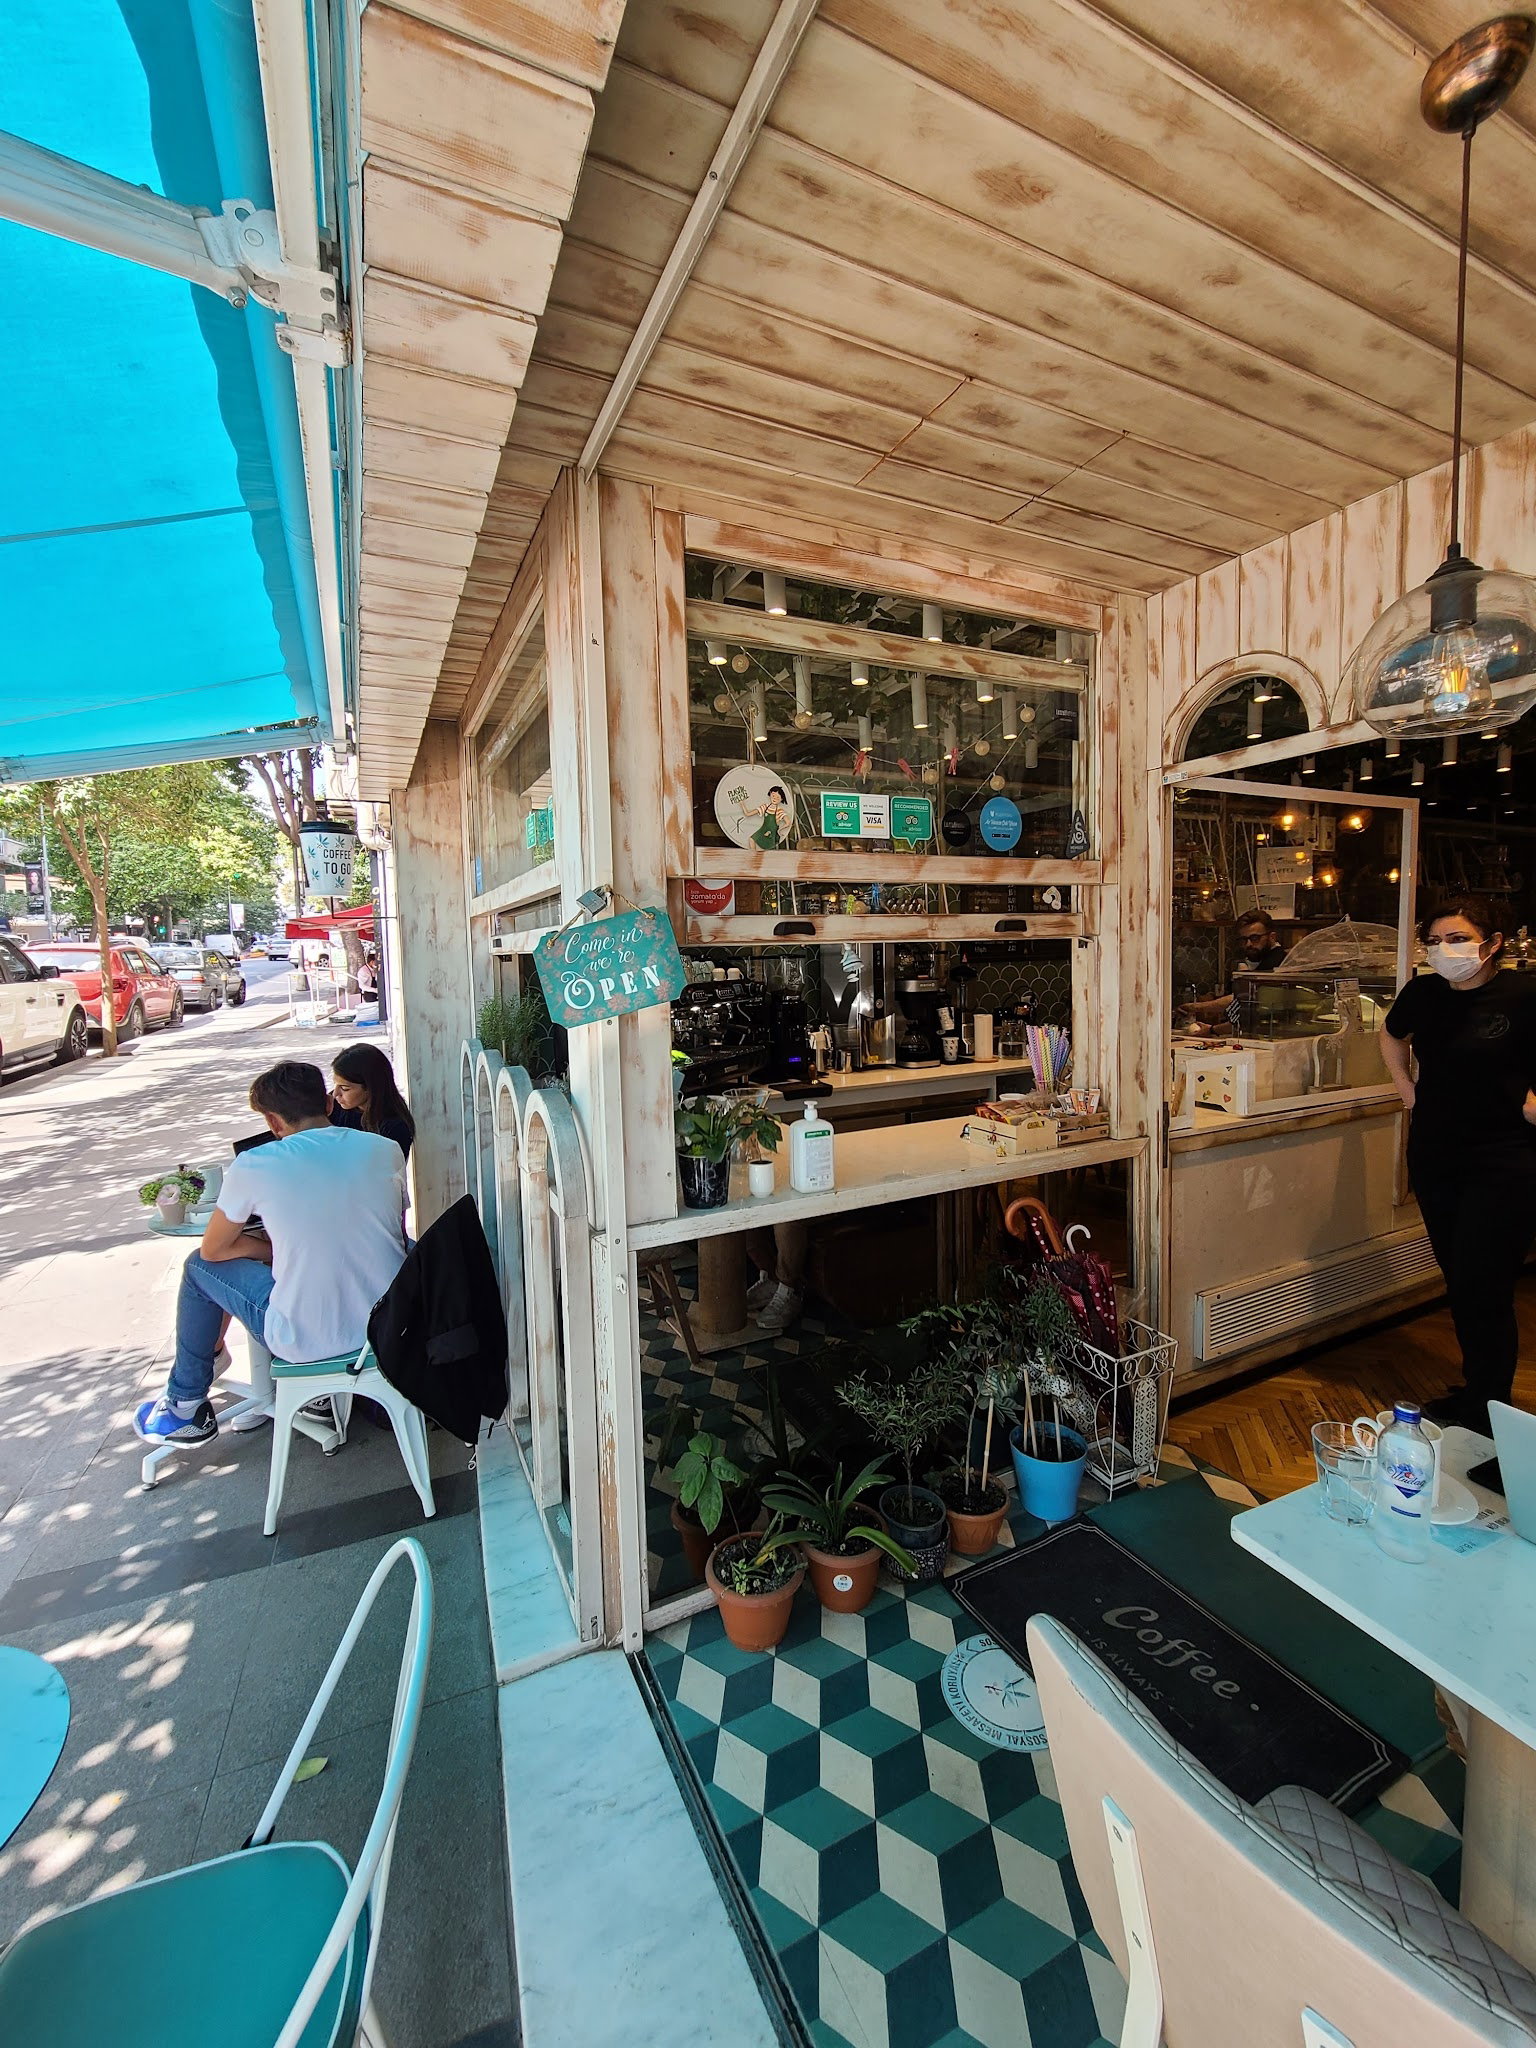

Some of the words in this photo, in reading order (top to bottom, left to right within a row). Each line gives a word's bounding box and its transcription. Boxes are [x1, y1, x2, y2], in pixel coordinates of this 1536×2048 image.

[825, 801, 849, 809] REVIEW
[866, 816, 882, 825] VISA
[323, 848, 351, 860] COFFEE
[323, 862, 338, 875] TO
[340, 863, 351, 875] GO
[564, 932, 615, 964] Come
[621, 927, 643, 943] in
[583, 948, 635, 976] we're
[560, 964, 661, 1010] OPEN
[1101, 1605, 1241, 1700] Coffee
[1091, 1637, 1108, 1651] IS
[1106, 1651, 1165, 1701] ALWAYS
